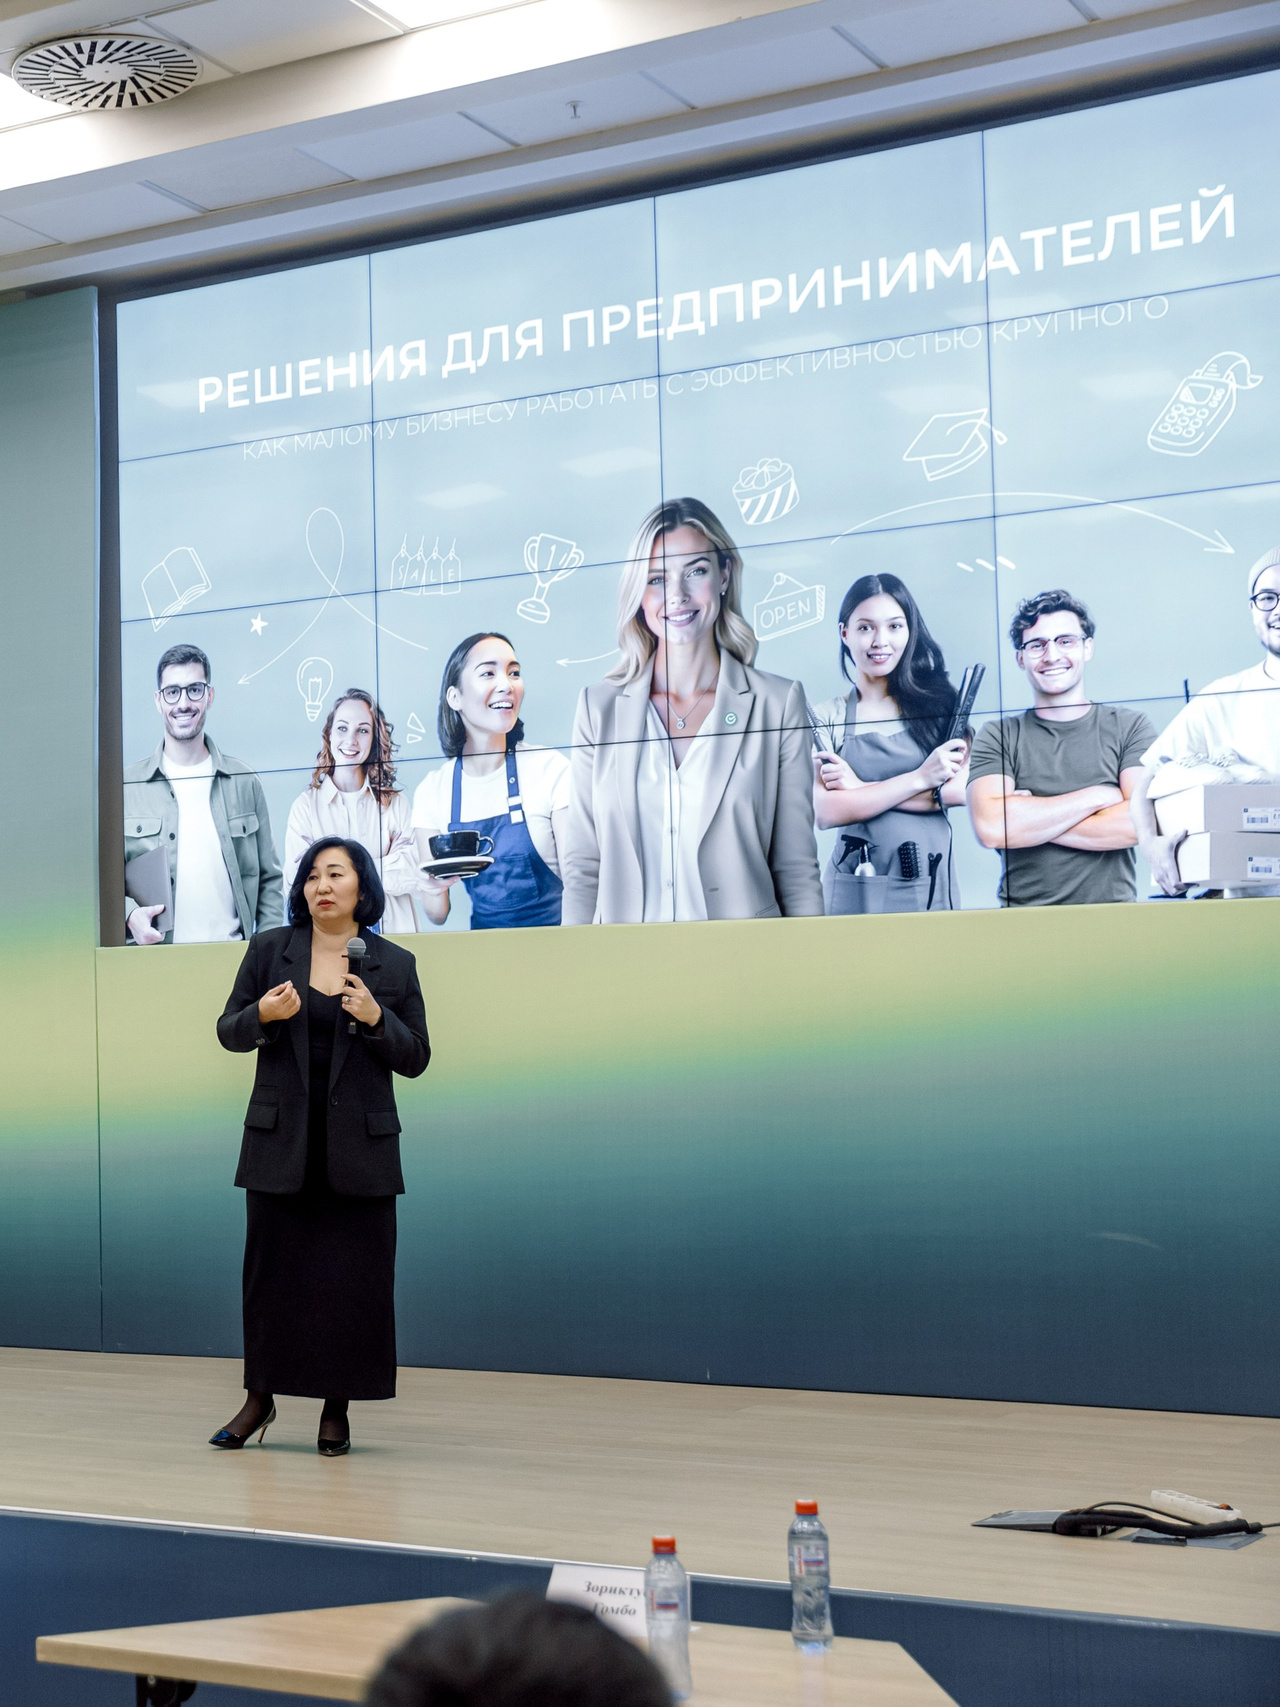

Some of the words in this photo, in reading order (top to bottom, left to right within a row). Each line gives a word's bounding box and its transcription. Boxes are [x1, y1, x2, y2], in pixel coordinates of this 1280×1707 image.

[198, 339, 427, 414] РЕШЕНИЯ
[441, 317, 544, 379] ДЛЯ
[562, 183, 1236, 352] ПРЕДПРИНИМАТЕЛЕЙ
[243, 436, 288, 461] КАК
[294, 418, 400, 454] МАЛОМУ
[407, 399, 519, 437] БИЗНЕСУ
[526, 377, 659, 417] РАБОТАТЬ
[666, 373, 684, 396] С
[690, 326, 983, 392] ЭФФЕКТИВНОСТЬЮ
[993, 295, 1169, 344] КРУПНОГО
[398, 565, 455, 582] SALE
[760, 597, 810, 629] OPEN
[582, 1580, 642, 1599] Зорикту
